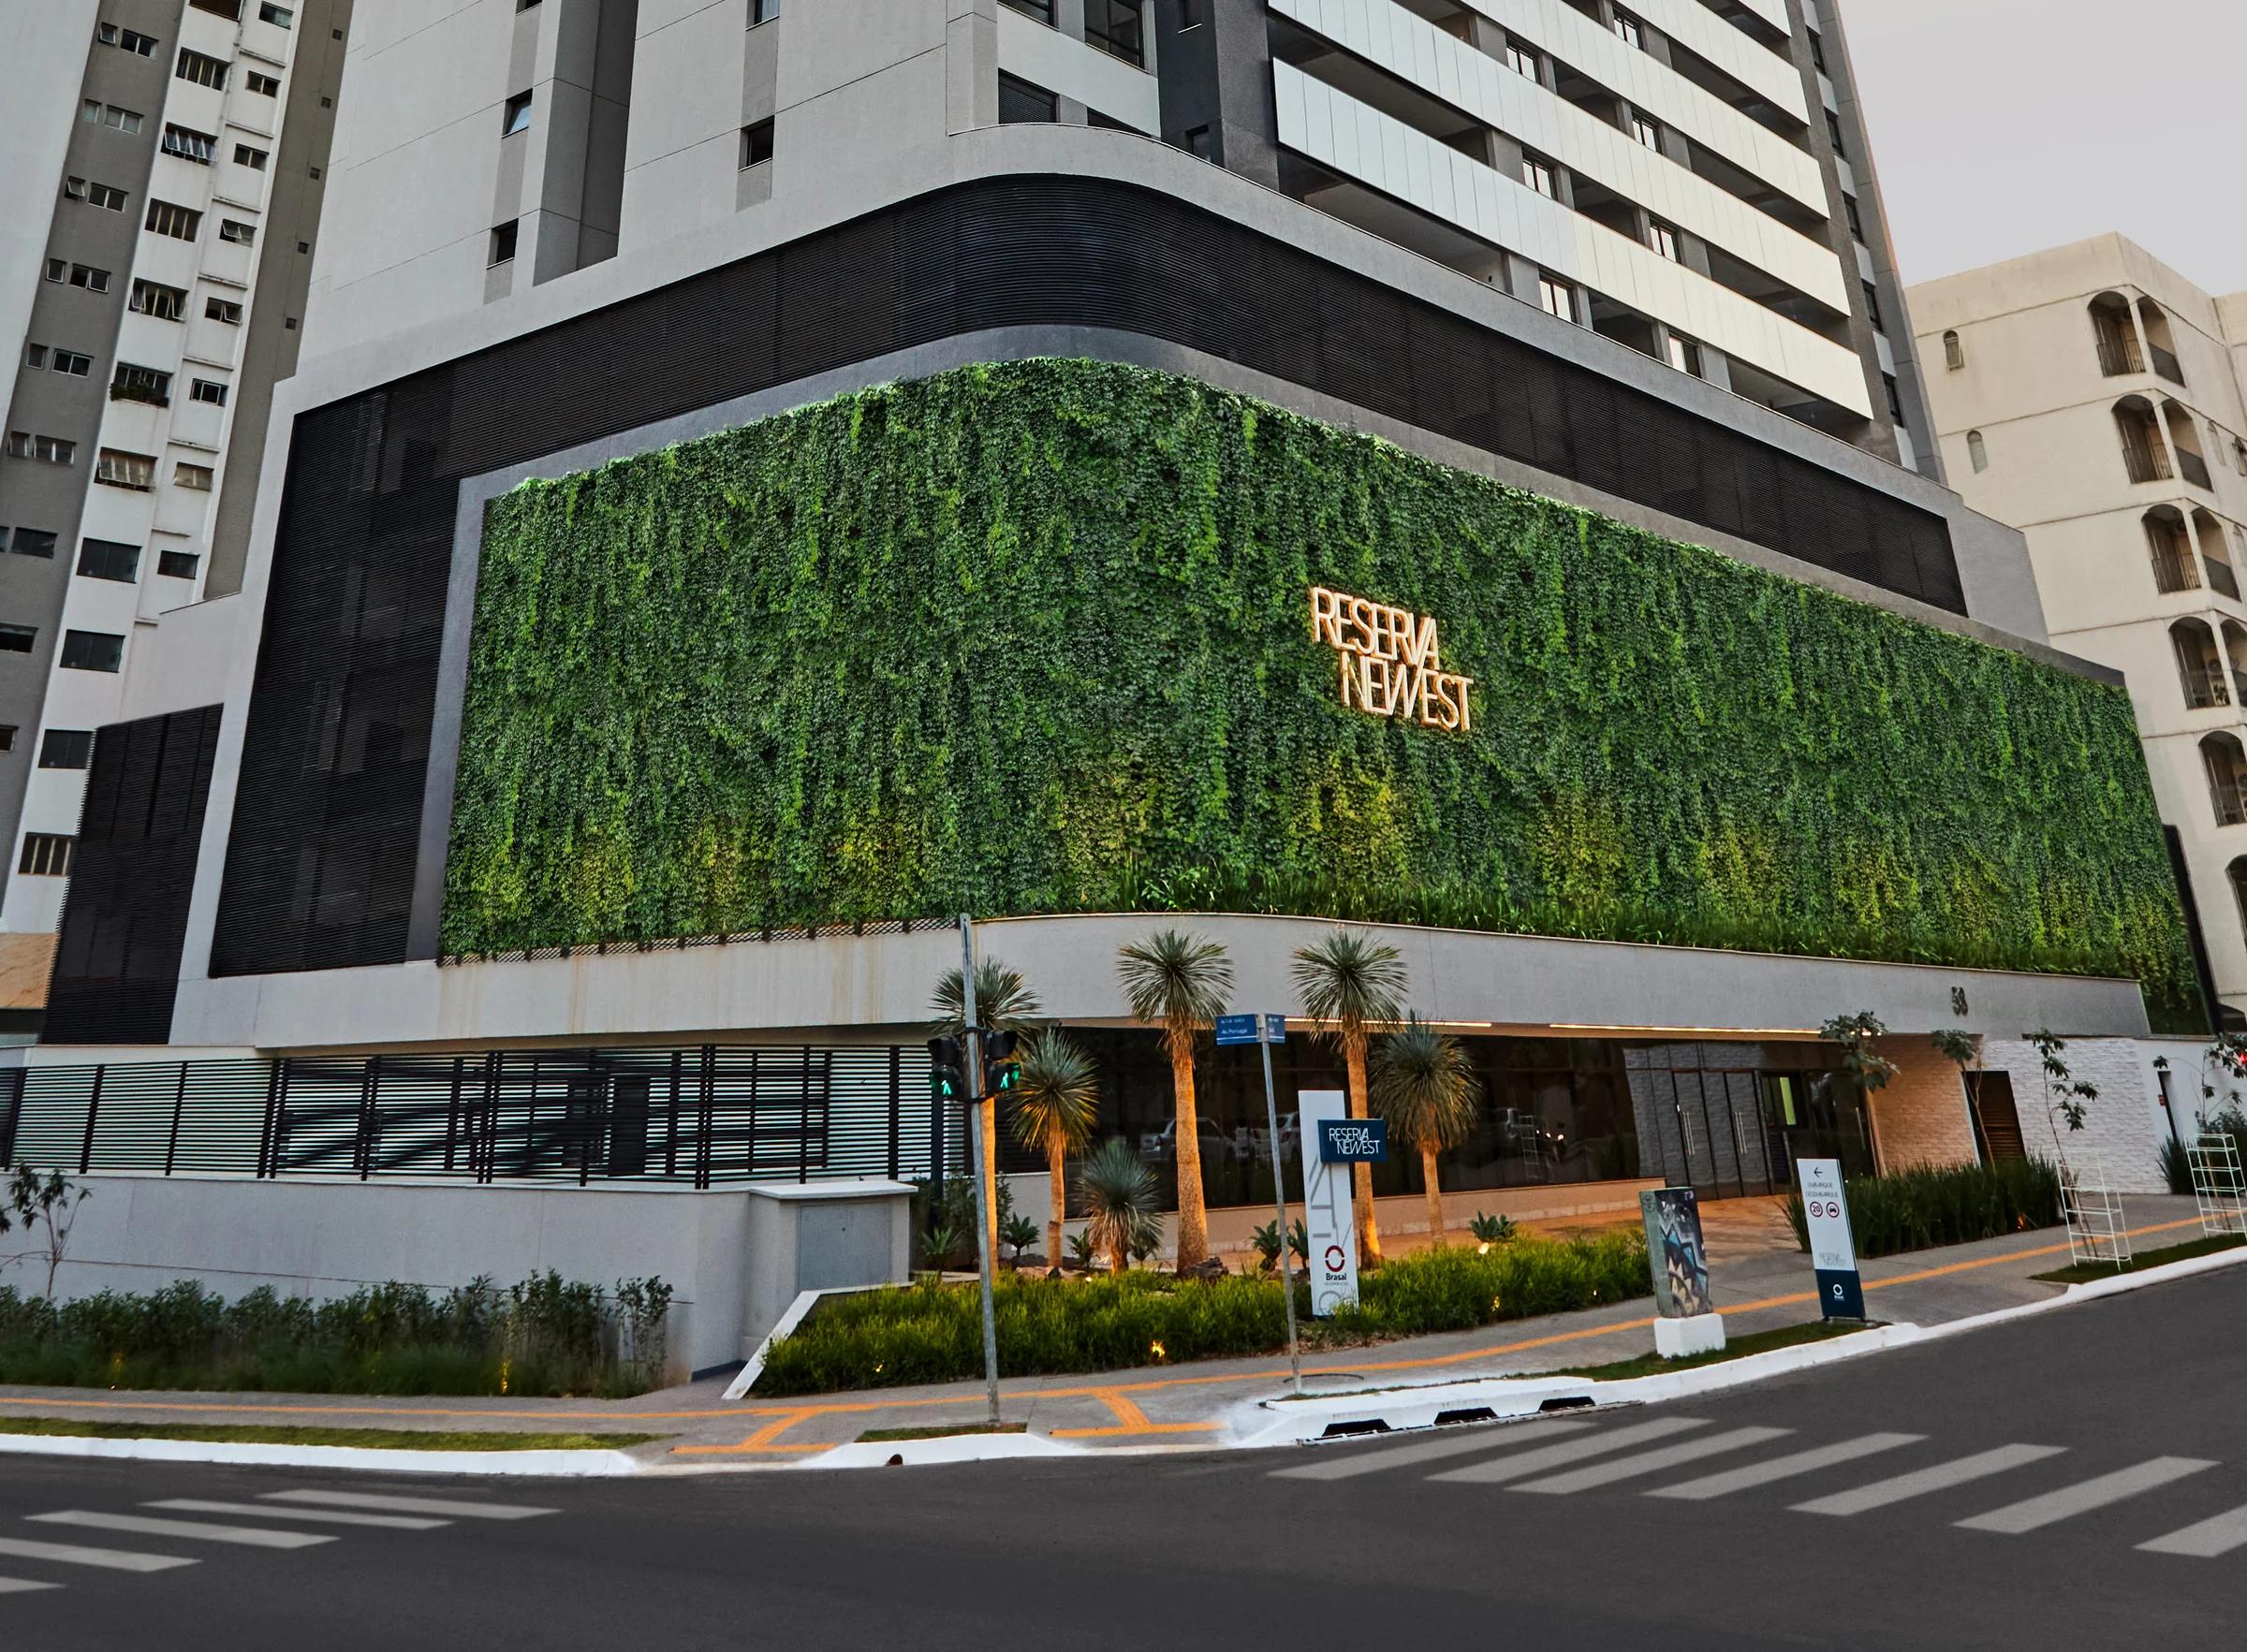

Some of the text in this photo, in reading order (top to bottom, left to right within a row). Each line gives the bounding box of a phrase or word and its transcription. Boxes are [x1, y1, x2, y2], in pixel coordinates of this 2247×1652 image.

[1311, 587, 1440, 670] RESERVA
[1340, 651, 1475, 731] NEWEST
[1329, 1128, 1369, 1142] RESERVA
[1337, 1140, 1380, 1154] NEWEST
[1326, 1273, 1346, 1281] Brasal
